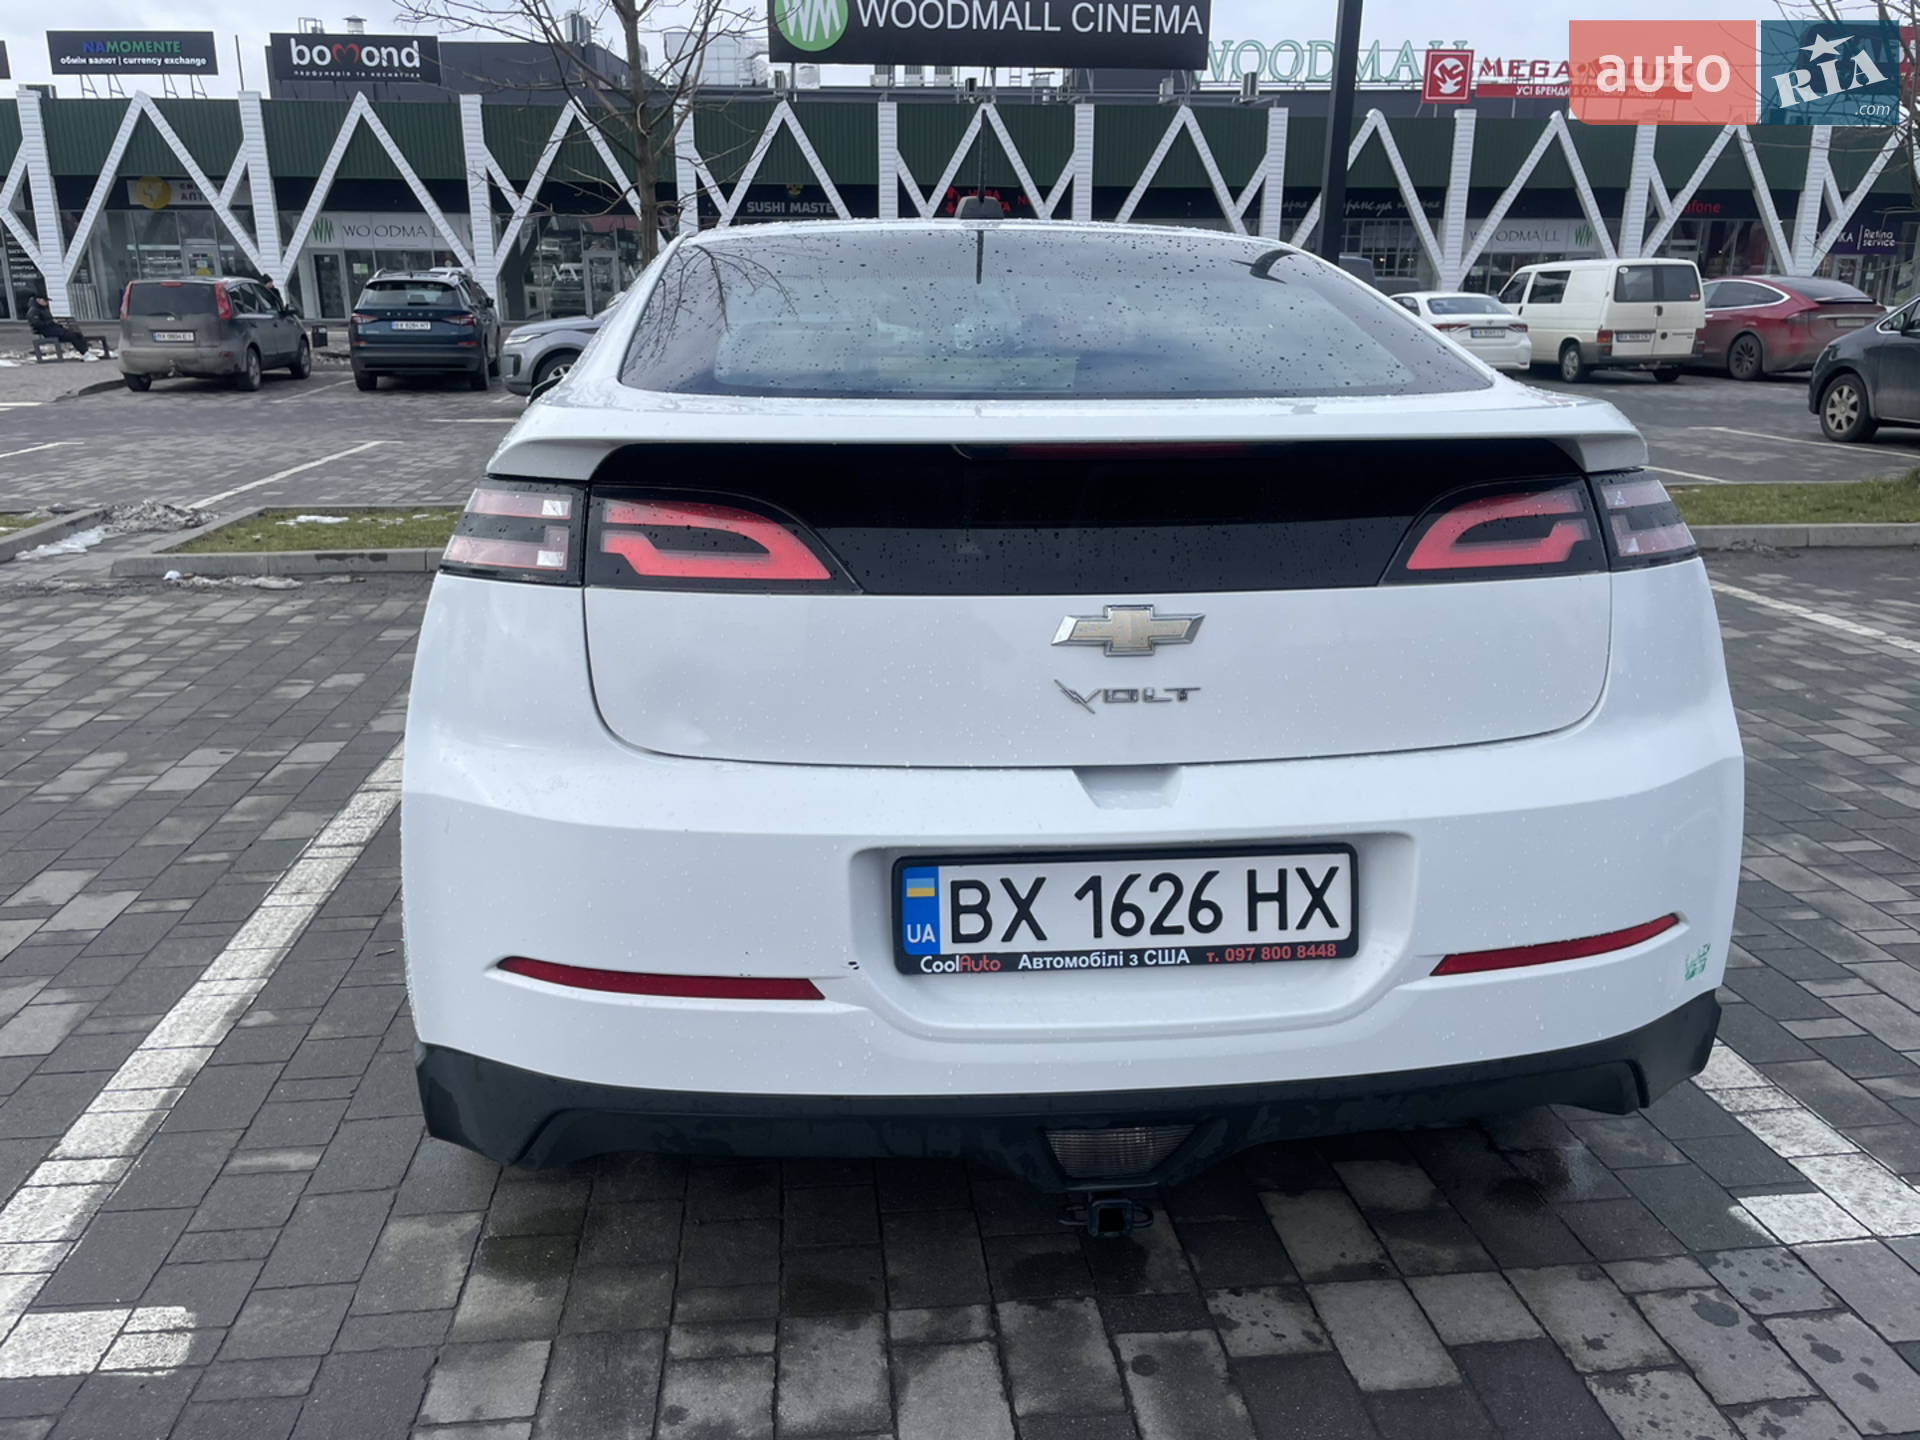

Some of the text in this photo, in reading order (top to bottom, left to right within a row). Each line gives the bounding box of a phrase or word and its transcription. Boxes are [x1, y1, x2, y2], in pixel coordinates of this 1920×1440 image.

[856, 0, 1204, 35] WOODMALL CINEMA
[82, 41, 181, 53] NAMOMENTE
[123, 58, 162, 66] currency
[164, 56, 207, 66] exchange
[1194, 39, 1473, 82] WOODMA
[746, 201, 838, 214] SUSHI MASTE
[1054, 679, 1202, 714] VOLT
[950, 865, 1340, 944] BX 1626 HX
[906, 923, 936, 944] UA
[919, 954, 1002, 973] CoolAuto
[1017, 950, 1124, 970] Автомобілі
[1143, 948, 1191, 966] США
[1224, 947, 1256, 963] 097
[1260, 945, 1292, 961] 800
[1296, 943, 1337, 959] 8448
